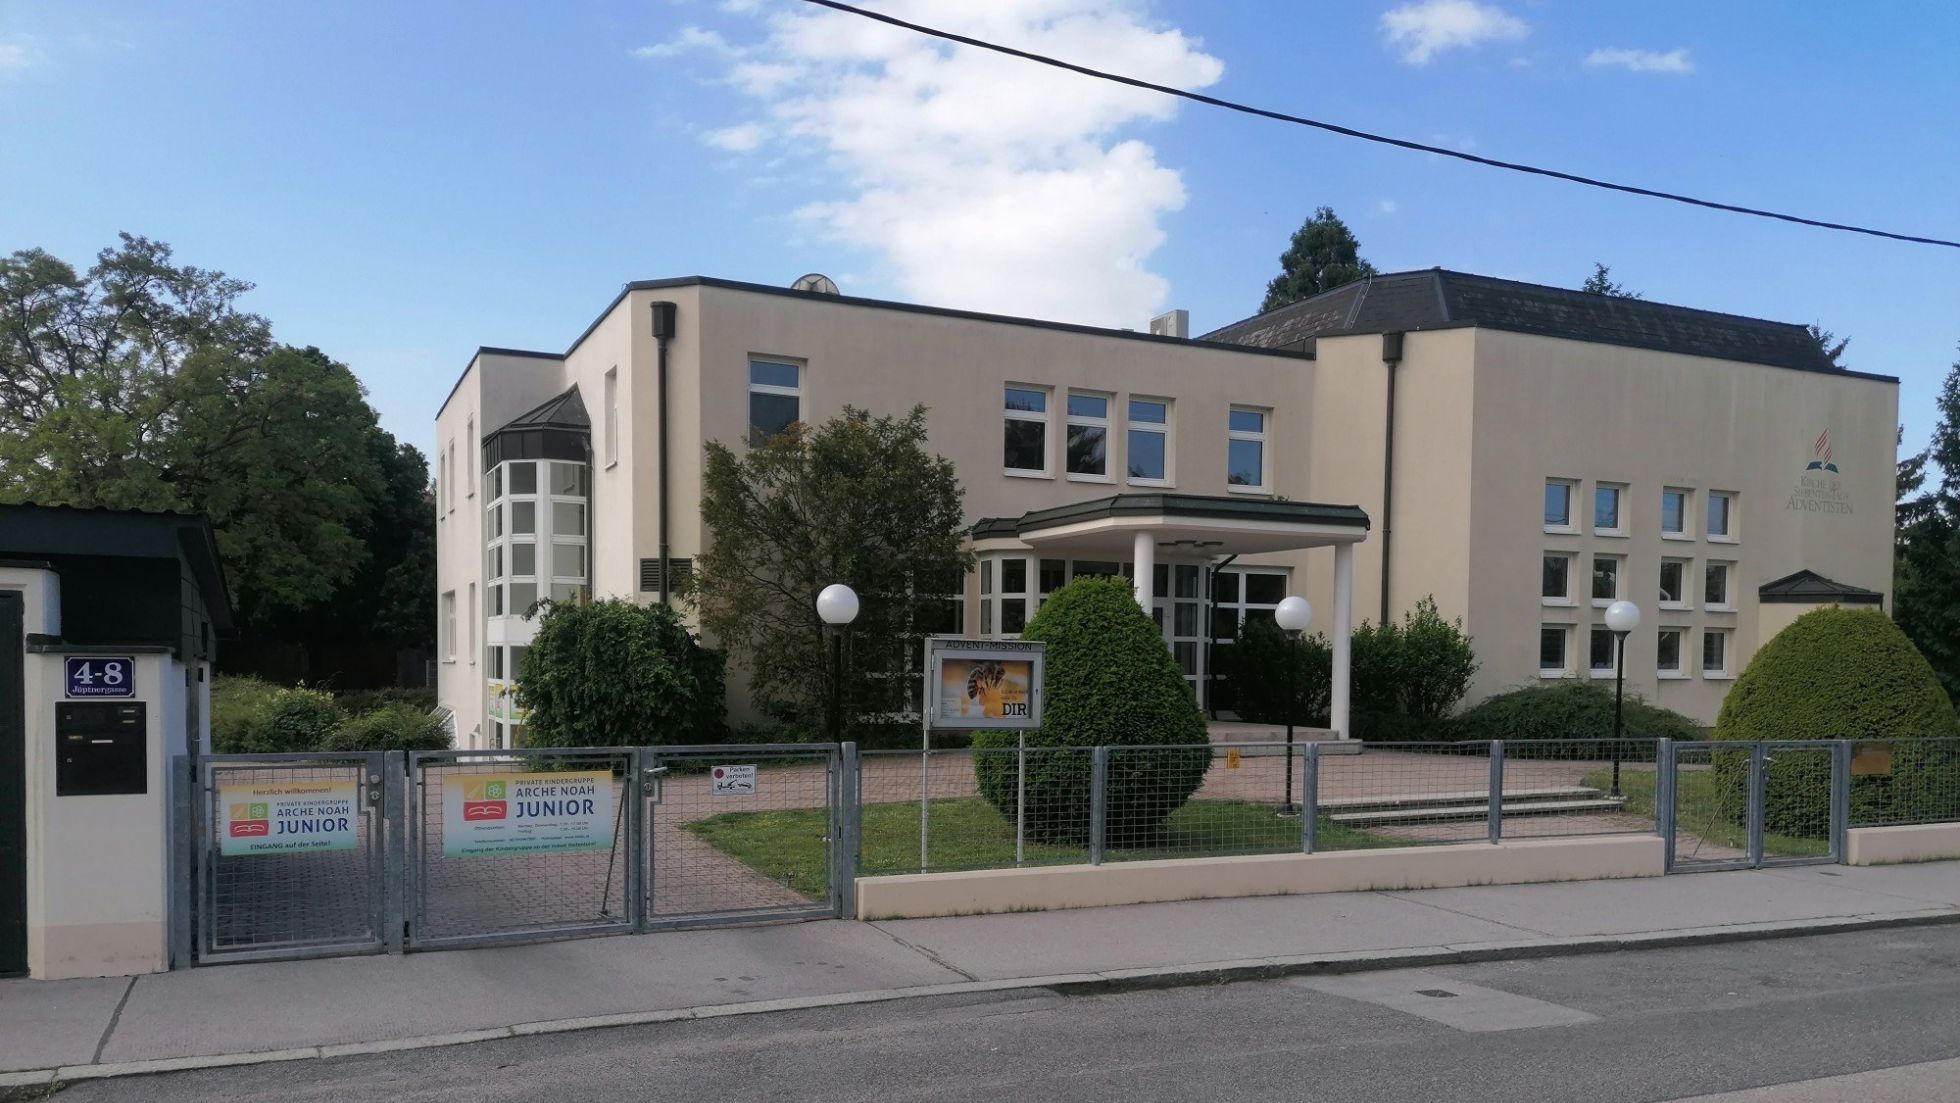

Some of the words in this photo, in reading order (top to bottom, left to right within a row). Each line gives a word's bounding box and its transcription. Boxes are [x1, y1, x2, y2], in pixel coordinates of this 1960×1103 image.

[945, 640, 1032, 651] ADVENT-MISSION
[74, 661, 123, 685] 4-8
[1001, 702, 1027, 716] DIR
[544, 777, 595, 785] KINDERGRUPPE
[253, 788, 283, 796] Herzlich
[515, 787, 557, 797] ARCHE
[561, 785, 595, 796] NOAH
[276, 807, 314, 817] ARCHE
[318, 806, 349, 815] NOAH
[515, 799, 595, 818] JUNIOR
[277, 817, 349, 835] JUNIOR
[285, 841, 296, 849] auf
